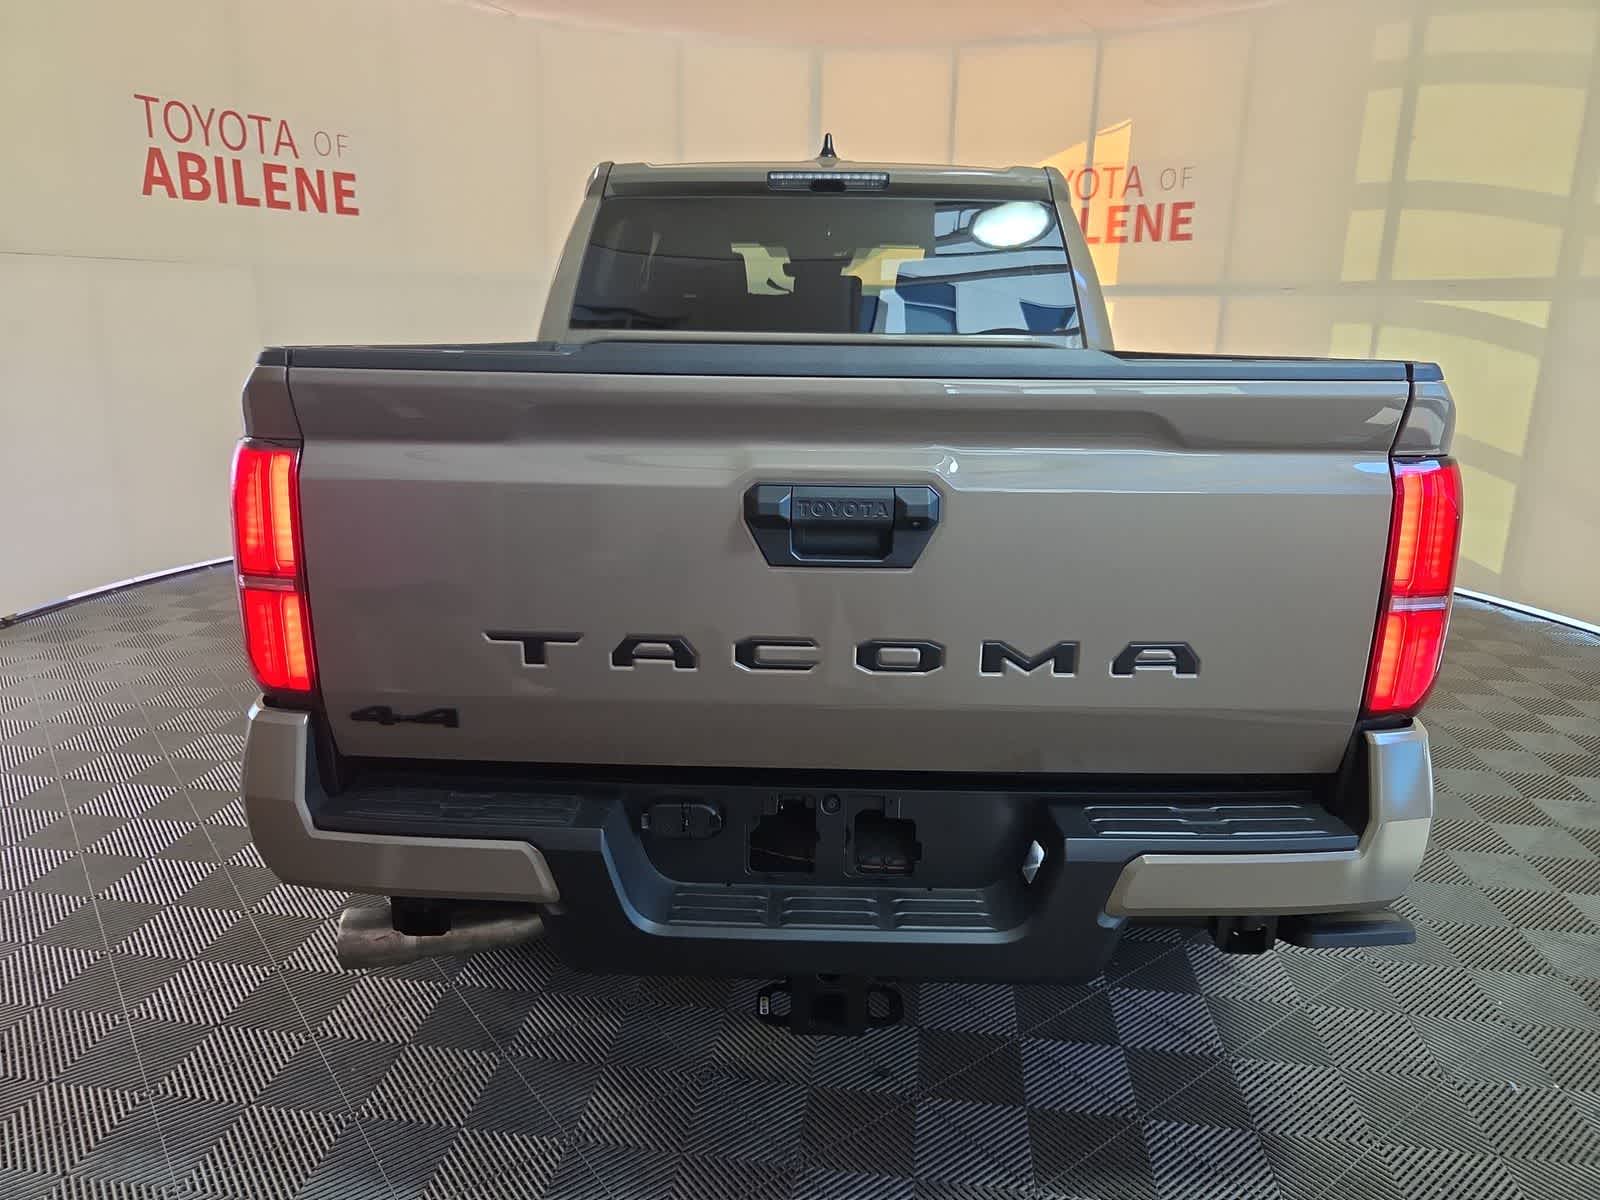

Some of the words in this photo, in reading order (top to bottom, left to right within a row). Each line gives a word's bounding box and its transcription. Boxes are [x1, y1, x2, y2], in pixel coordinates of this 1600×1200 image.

[134, 94, 299, 159] TOYOTA
[313, 130, 348, 157] OF
[142, 147, 359, 216] ABILENE
[1160, 166, 1196, 191] OF
[798, 500, 889, 518] TOYOTA
[482, 630, 1201, 679] TACOMA
